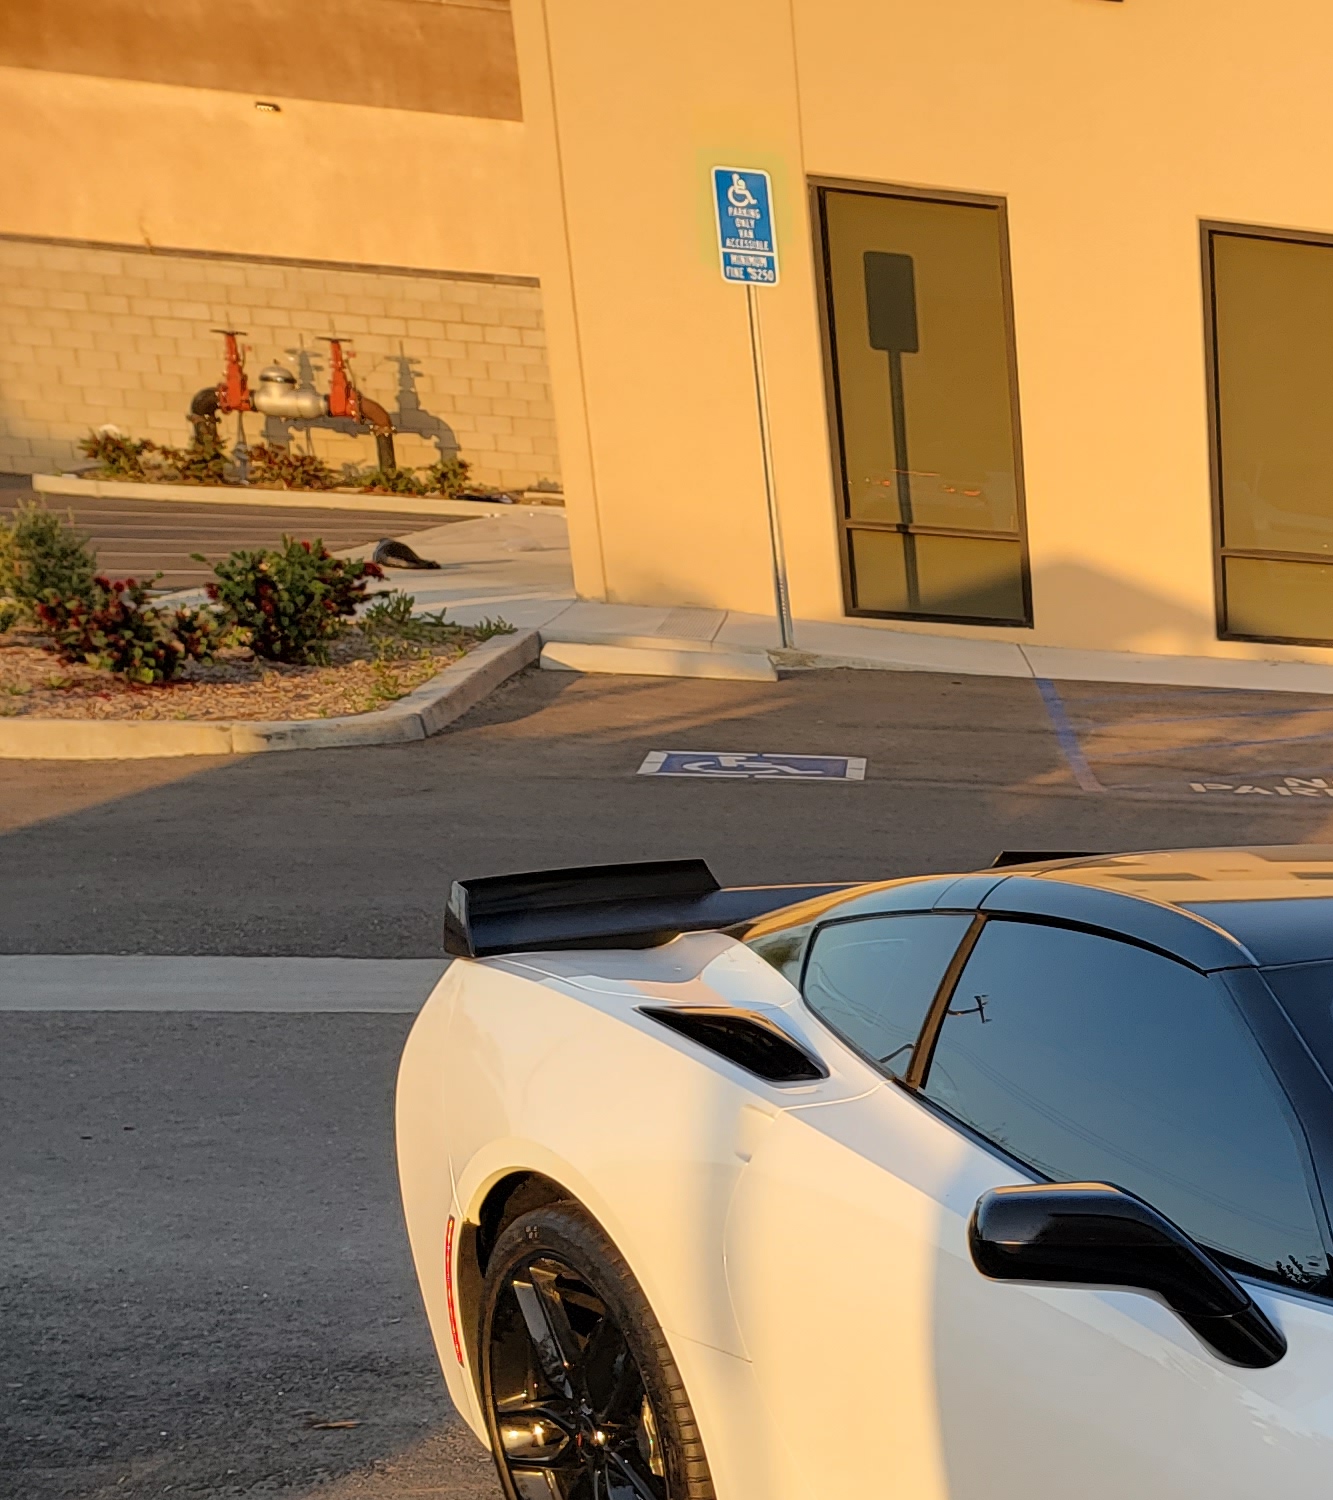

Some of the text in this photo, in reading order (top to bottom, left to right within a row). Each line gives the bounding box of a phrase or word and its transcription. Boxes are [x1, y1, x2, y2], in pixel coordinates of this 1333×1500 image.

[728, 206, 760, 219] PARKING
[735, 218, 755, 229] ONLY
[738, 229, 754, 239] VAN
[726, 237, 769, 250] ACCESSIBLE
[726, 266, 775, 282] FINE $250
